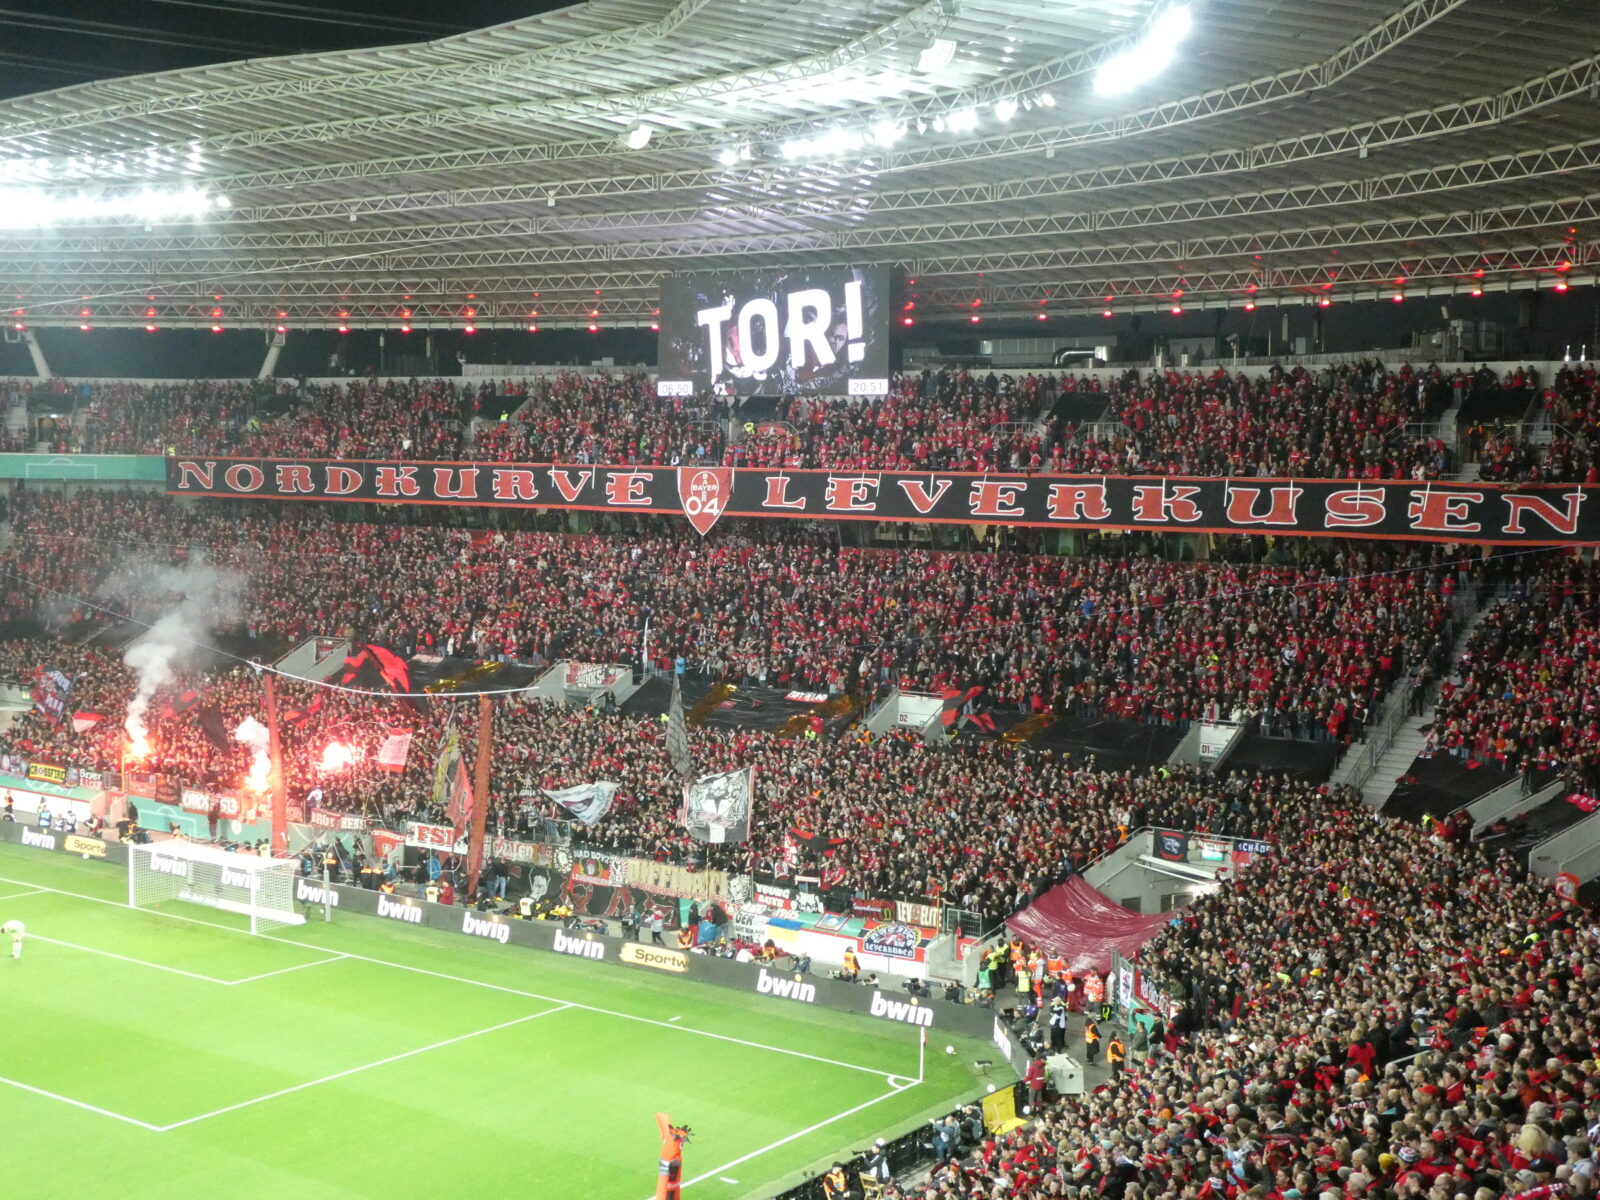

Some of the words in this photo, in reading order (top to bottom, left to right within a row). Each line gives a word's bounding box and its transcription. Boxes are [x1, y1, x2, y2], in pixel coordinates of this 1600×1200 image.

[697, 281, 865, 385] TOR!
[178, 461, 653, 505] NORDKURVE
[686, 496, 720, 516] 04
[762, 477, 1586, 535] LEVERKUSEN
[899, 714, 908, 722] D2
[1202, 745, 1210, 754] D1
[22, 826, 55, 850] bwin
[152, 852, 187, 877] bwin
[297, 879, 339, 906] bwin
[377, 895, 422, 923] bwin
[463, 912, 510, 944] bwin
[554, 930, 604, 960] bwin
[635, 949, 688, 968] Sportw
[757, 969, 816, 1003] bwin
[870, 991, 934, 1027] bwin
[994, 1015, 1012, 1061] bwin
